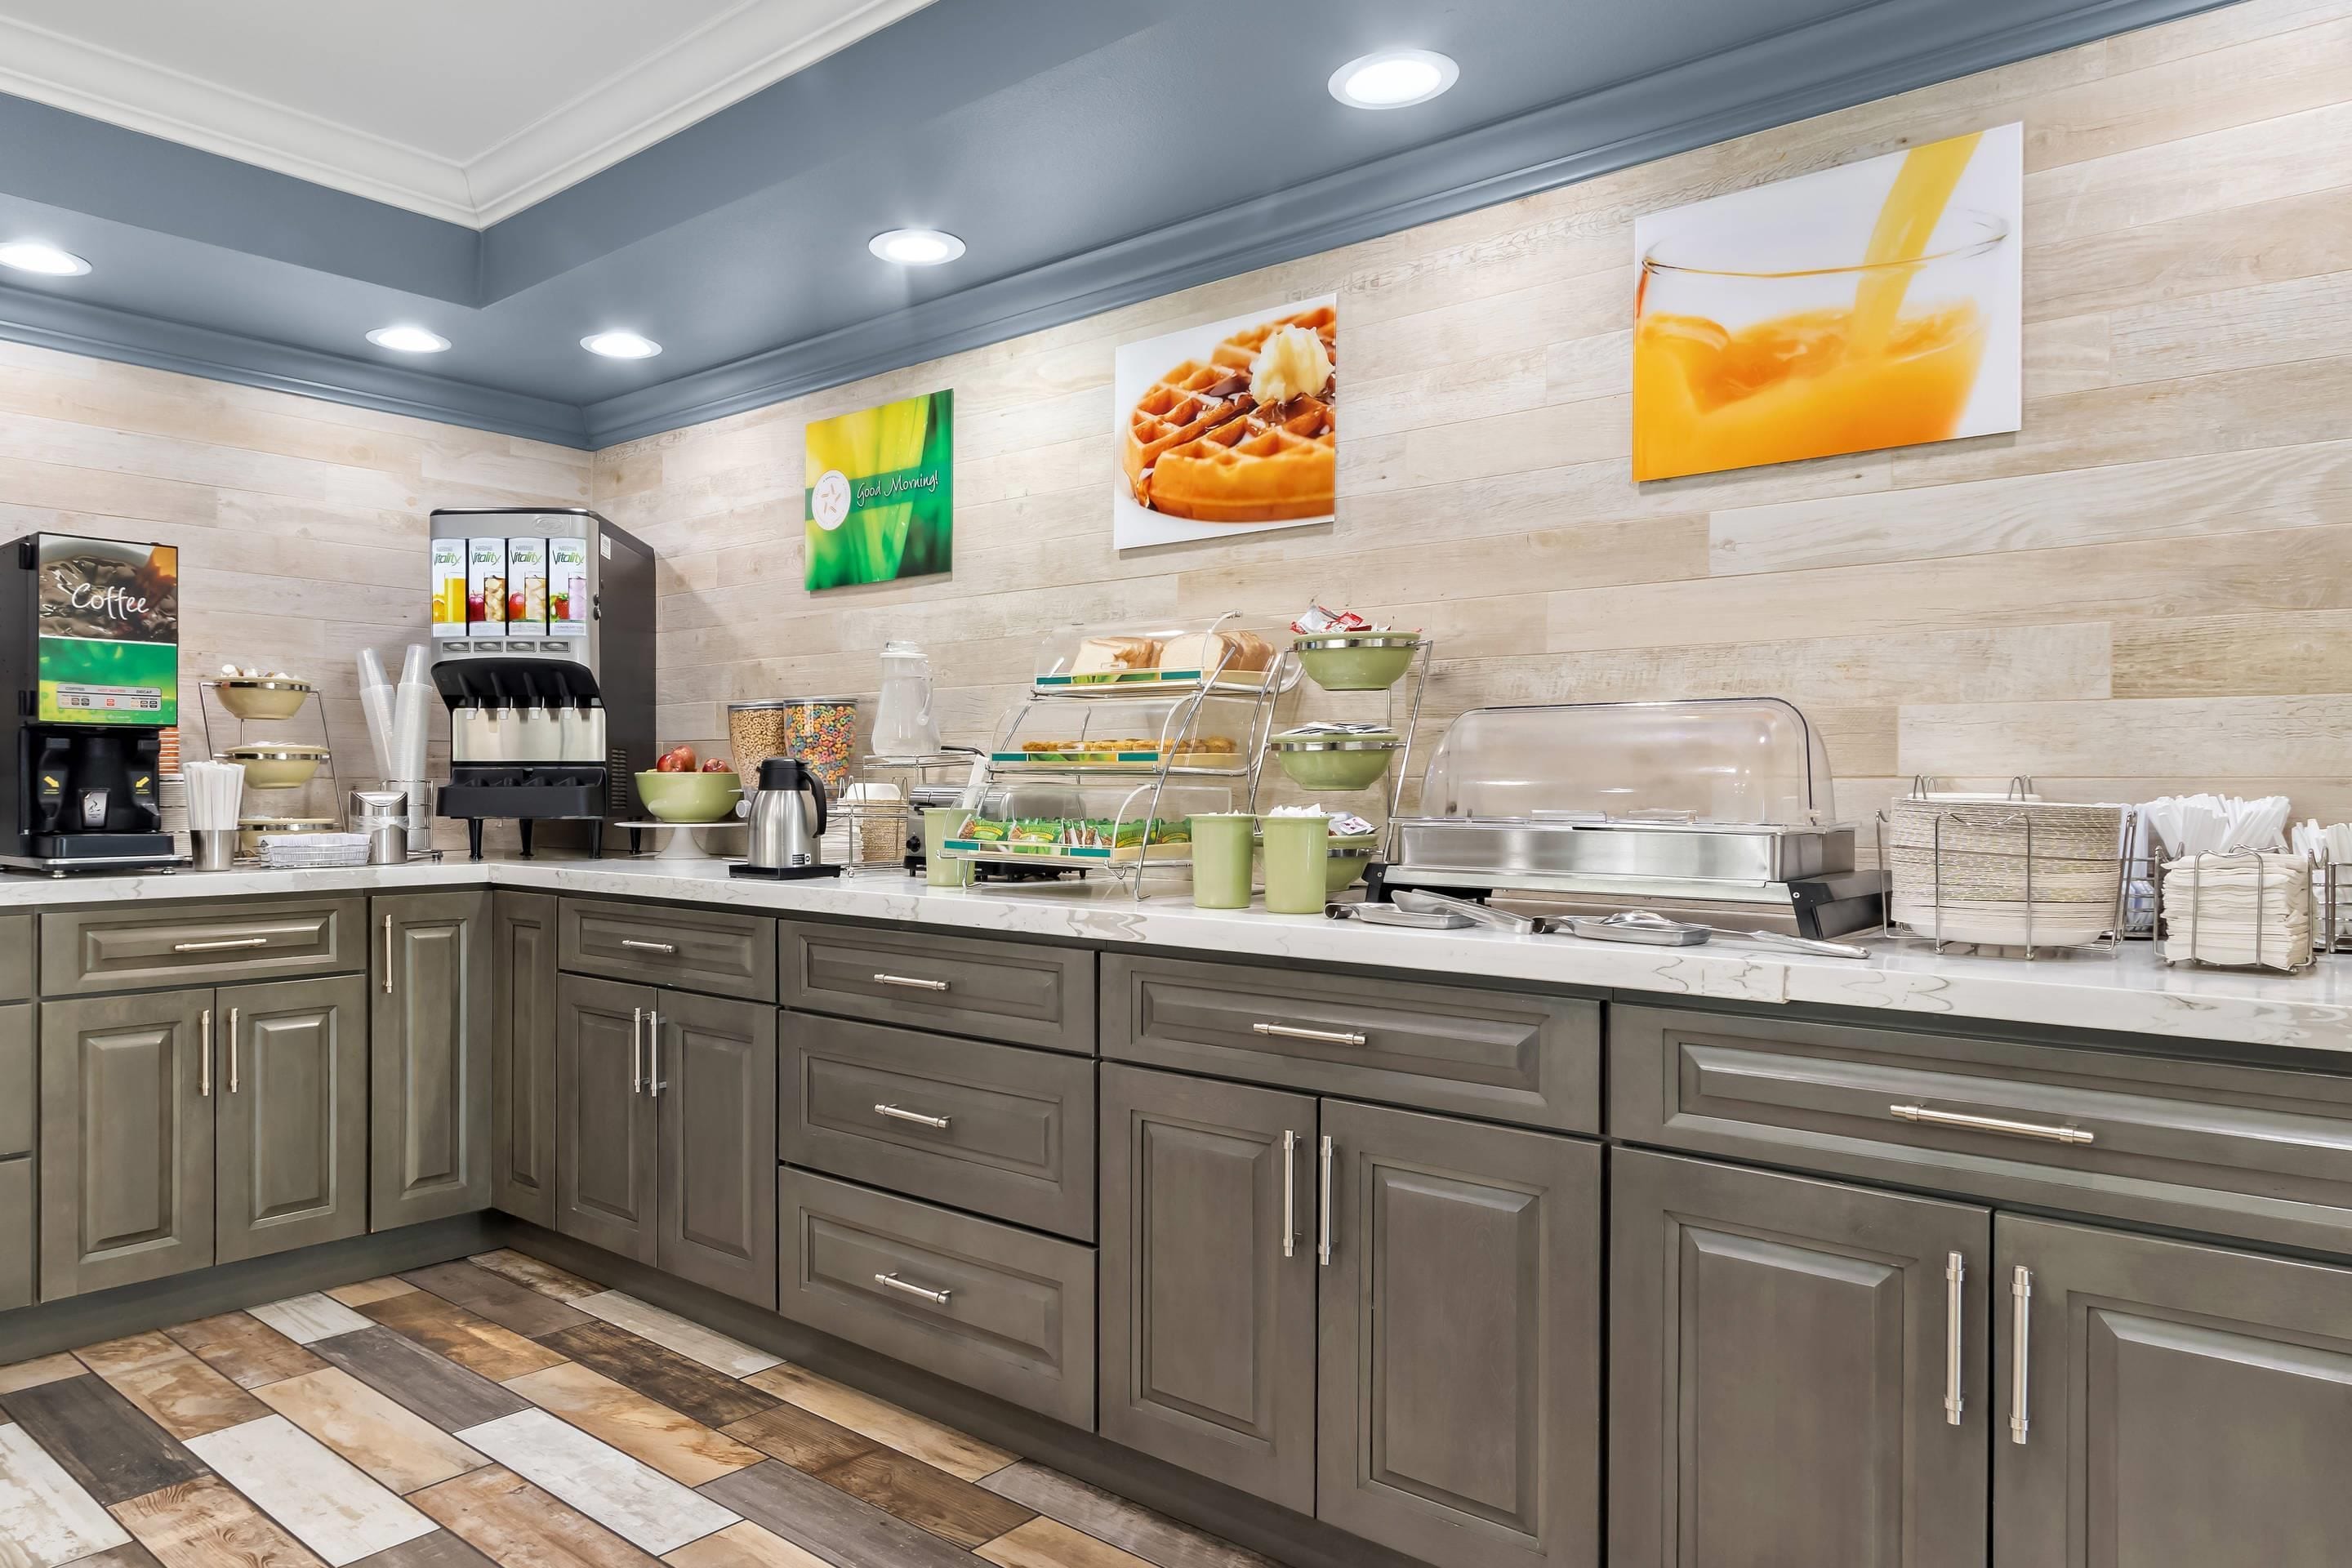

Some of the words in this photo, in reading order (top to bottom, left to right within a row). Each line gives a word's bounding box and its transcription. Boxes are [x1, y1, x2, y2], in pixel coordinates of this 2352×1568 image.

[857, 479, 881, 507] Good
[884, 470, 938, 497] Morning!
[470, 550, 501, 566] Vitality
[510, 550, 542, 565] Vitality
[553, 550, 585, 566] Vitality
[71, 582, 149, 621] Coffee
